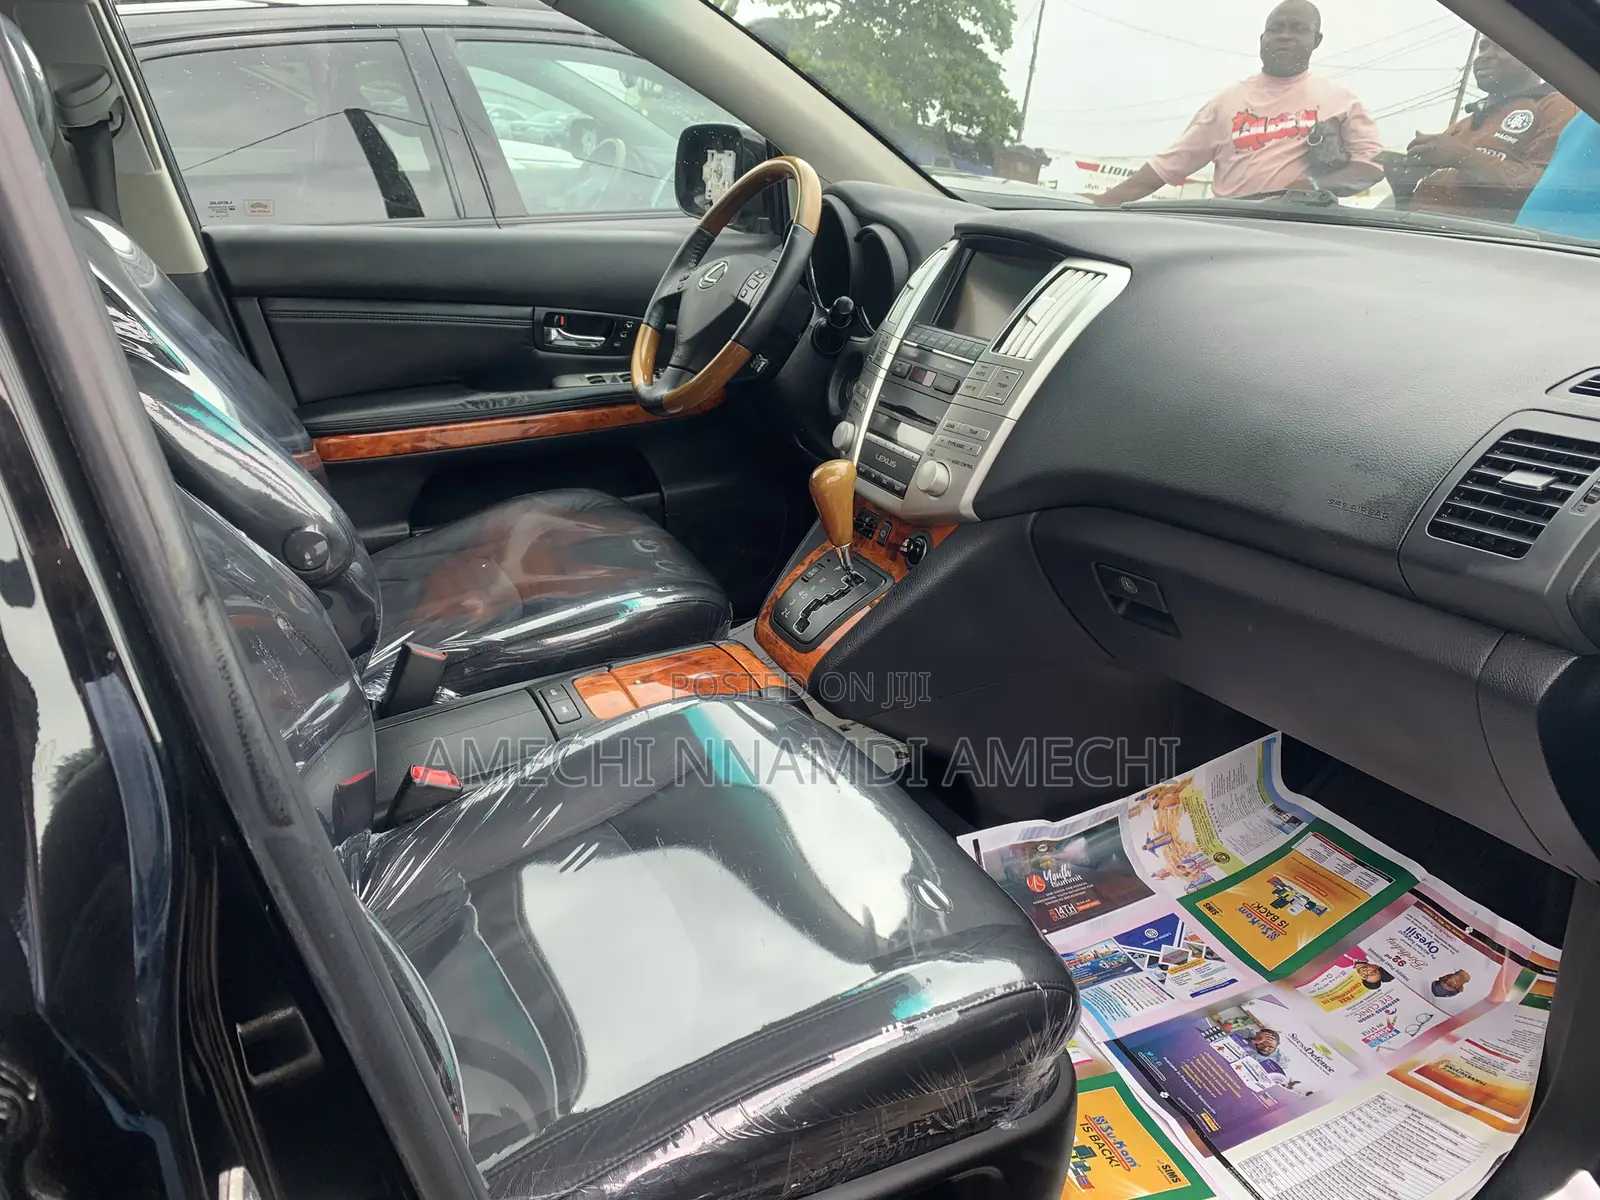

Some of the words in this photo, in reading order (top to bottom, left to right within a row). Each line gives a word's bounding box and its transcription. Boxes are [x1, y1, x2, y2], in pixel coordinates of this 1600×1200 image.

[875, 452, 897, 468] LEXUS
[1328, 499, 1348, 509] SRS
[1350, 504, 1390, 519] AIRBAG
[1054, 902, 1078, 918] 14TH
[1203, 902, 1220, 916] SIMS
[1251, 901, 1281, 923] BACK!
[1278, 919, 1290, 929] IS
[1403, 926, 1439, 954] Oyesiji
[1380, 995, 1393, 1006] EYE
[1354, 1003, 1380, 1018] CLINIC
[1366, 1026, 1391, 1040] SCHOOL
[1080, 1122, 1094, 1133] IS
[1088, 1135, 1121, 1168] BACK!
[1162, 1164, 1182, 1184] SIMS
